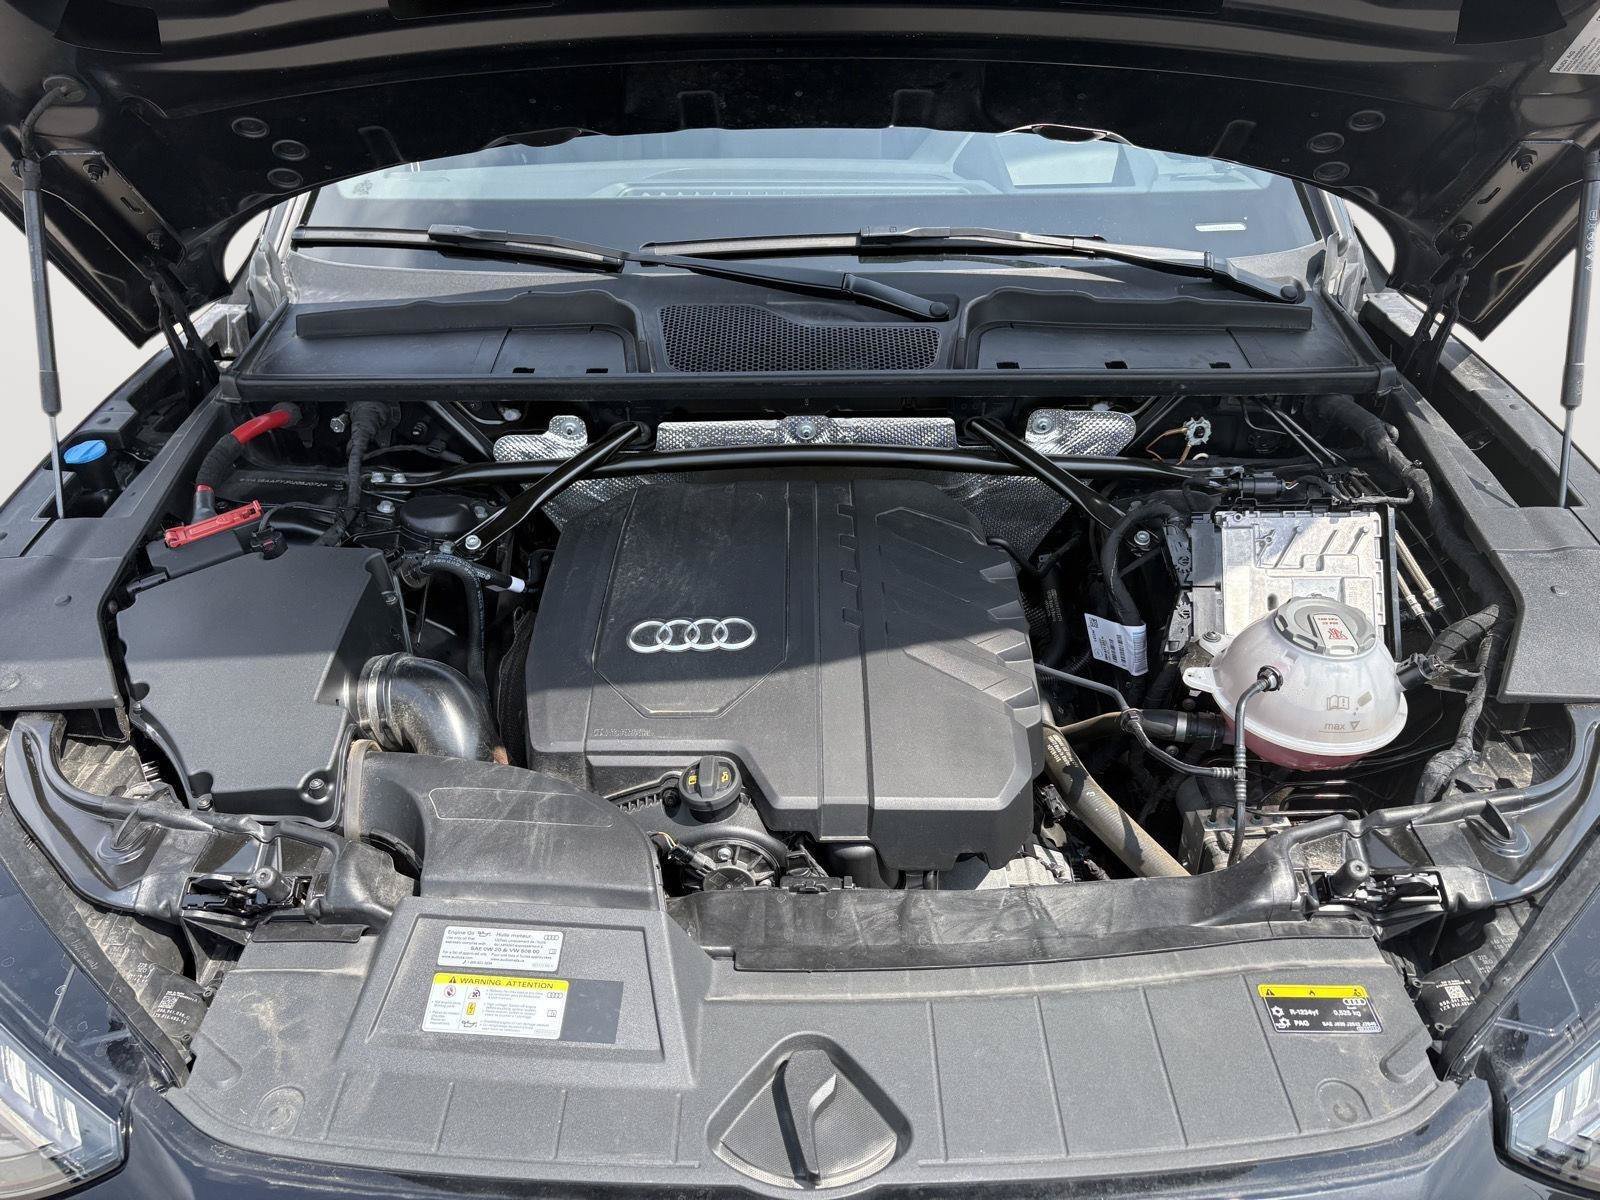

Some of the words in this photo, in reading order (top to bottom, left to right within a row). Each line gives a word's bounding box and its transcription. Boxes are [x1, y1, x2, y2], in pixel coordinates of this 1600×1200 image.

[1324, 722, 1346, 731] max
[460, 977, 502, 986] WARNING
[506, 979, 554, 989] ATTENTION
